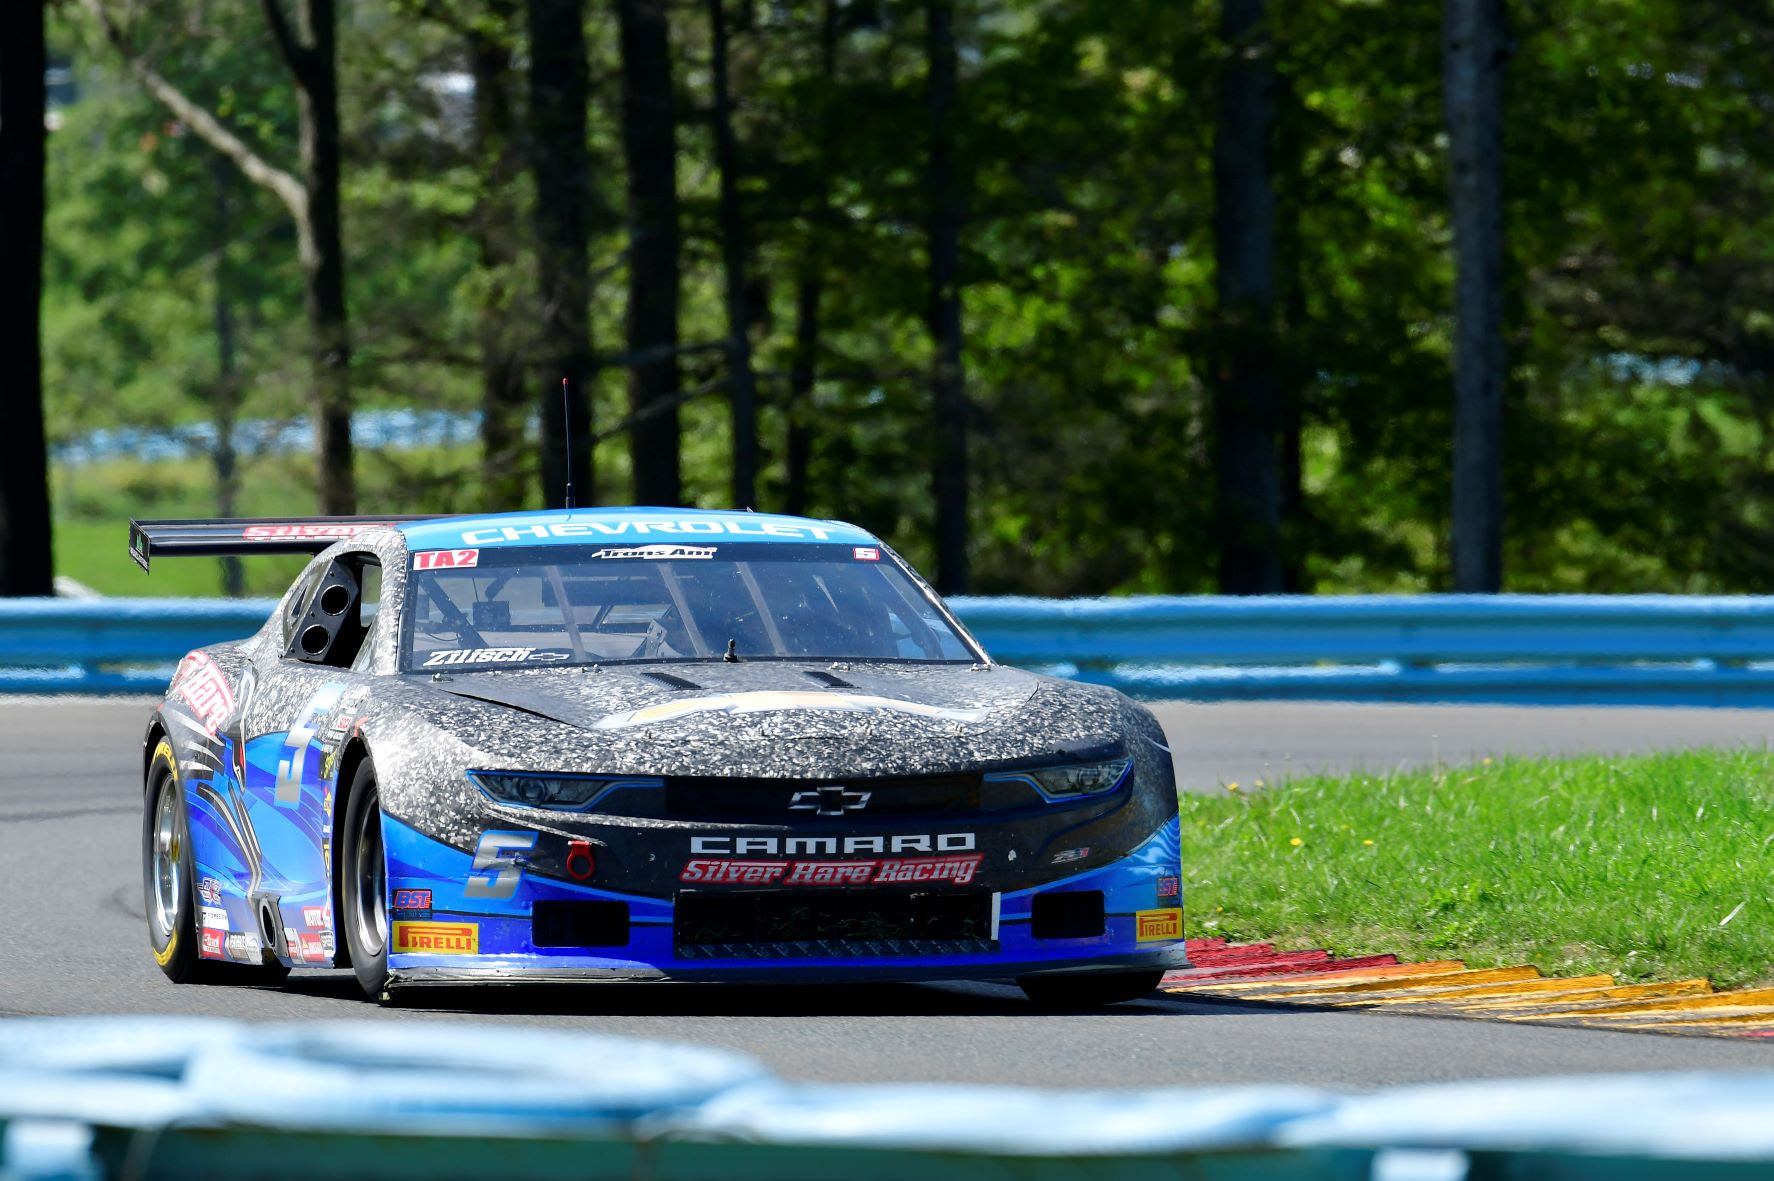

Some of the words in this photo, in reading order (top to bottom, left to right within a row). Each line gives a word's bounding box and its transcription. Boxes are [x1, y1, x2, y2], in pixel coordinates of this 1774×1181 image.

[461, 520, 834, 546] CHEVROLET
[415, 550, 478, 569] TA2
[600, 548, 666, 558] Trans
[669, 547, 715, 558] Am
[855, 547, 877, 559] 5
[422, 647, 537, 667] Zilisch
[690, 833, 976, 854] CAMARO
[464, 830, 539, 899] 5
[681, 859, 786, 884] Silver
[785, 860, 876, 884] Hare
[874, 855, 983, 884] Racing
[394, 891, 431, 909] BST
[1139, 913, 1177, 937] PIRELLI
[399, 926, 472, 950] PIRELLI
